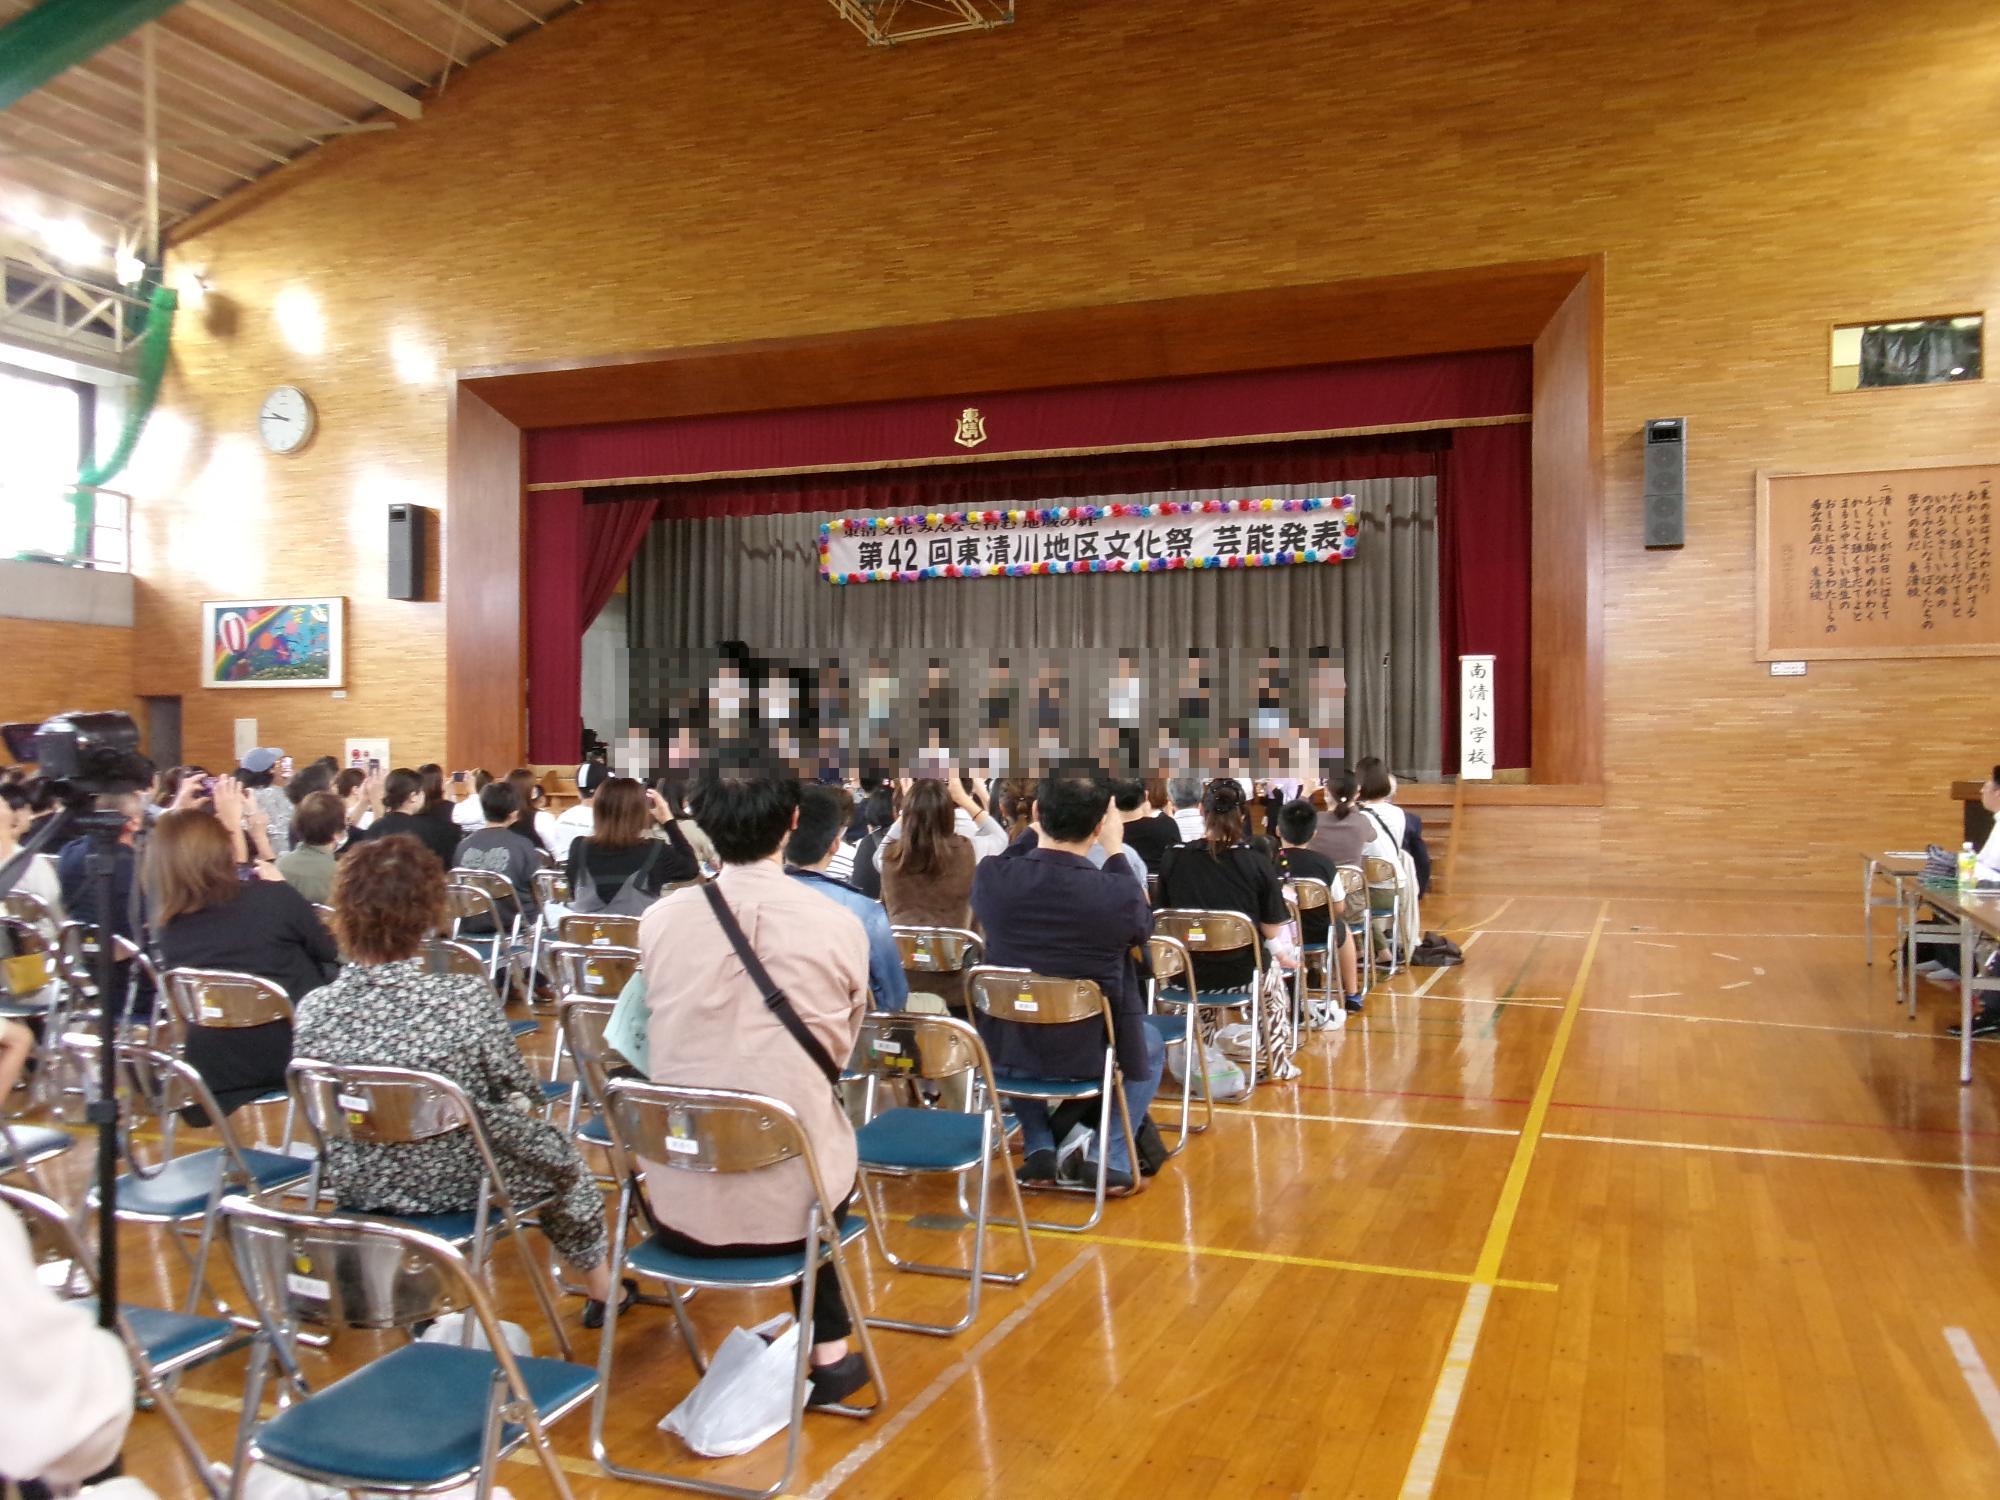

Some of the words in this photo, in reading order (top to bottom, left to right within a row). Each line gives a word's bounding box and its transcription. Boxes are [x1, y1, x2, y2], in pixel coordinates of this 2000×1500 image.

[857, 526, 1194, 572] 第42回東清川地区文化祭
[1212, 519, 1342, 558] 芸能発表
[1467, 662, 1489, 765] 南清小学校
